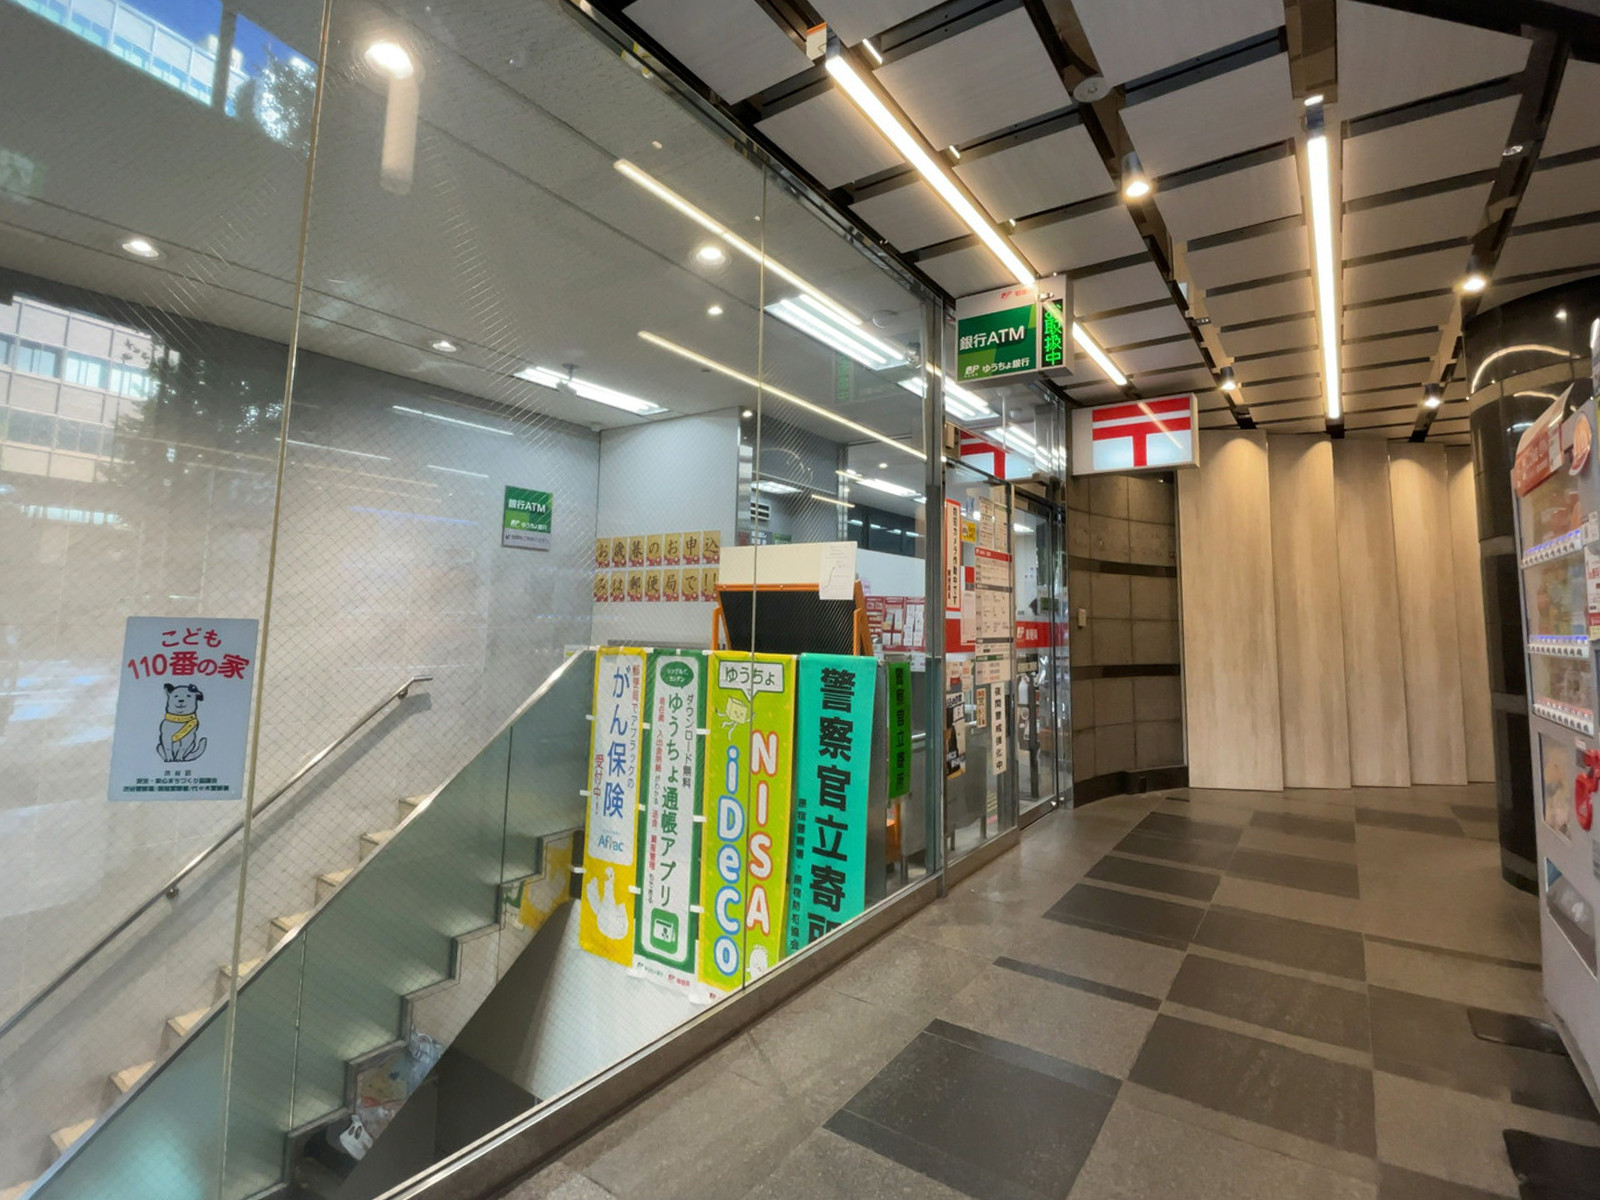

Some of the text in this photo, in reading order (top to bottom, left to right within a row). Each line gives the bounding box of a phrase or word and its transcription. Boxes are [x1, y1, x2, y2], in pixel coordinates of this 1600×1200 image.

[959, 325, 1025, 351] 銀行ATM
[982, 357, 1030, 373] ゆうちょ銀行
[508, 498, 546, 513] 銀行ATM
[598, 536, 719, 560] お歳暮のお申込
[162, 627, 222, 648] こども
[128, 651, 250, 680] 110番の家
[725, 666, 775, 686] ゆうちょ
[603, 665, 632, 819] がん保険
[682, 694, 695, 788] ダウンロード無料
[660, 692, 683, 907] ゆうちょ通帳アプリ
[598, 834, 624, 852] Aflac
[746, 729, 779, 937] NISA
[713, 745, 745, 977] iDeCo
